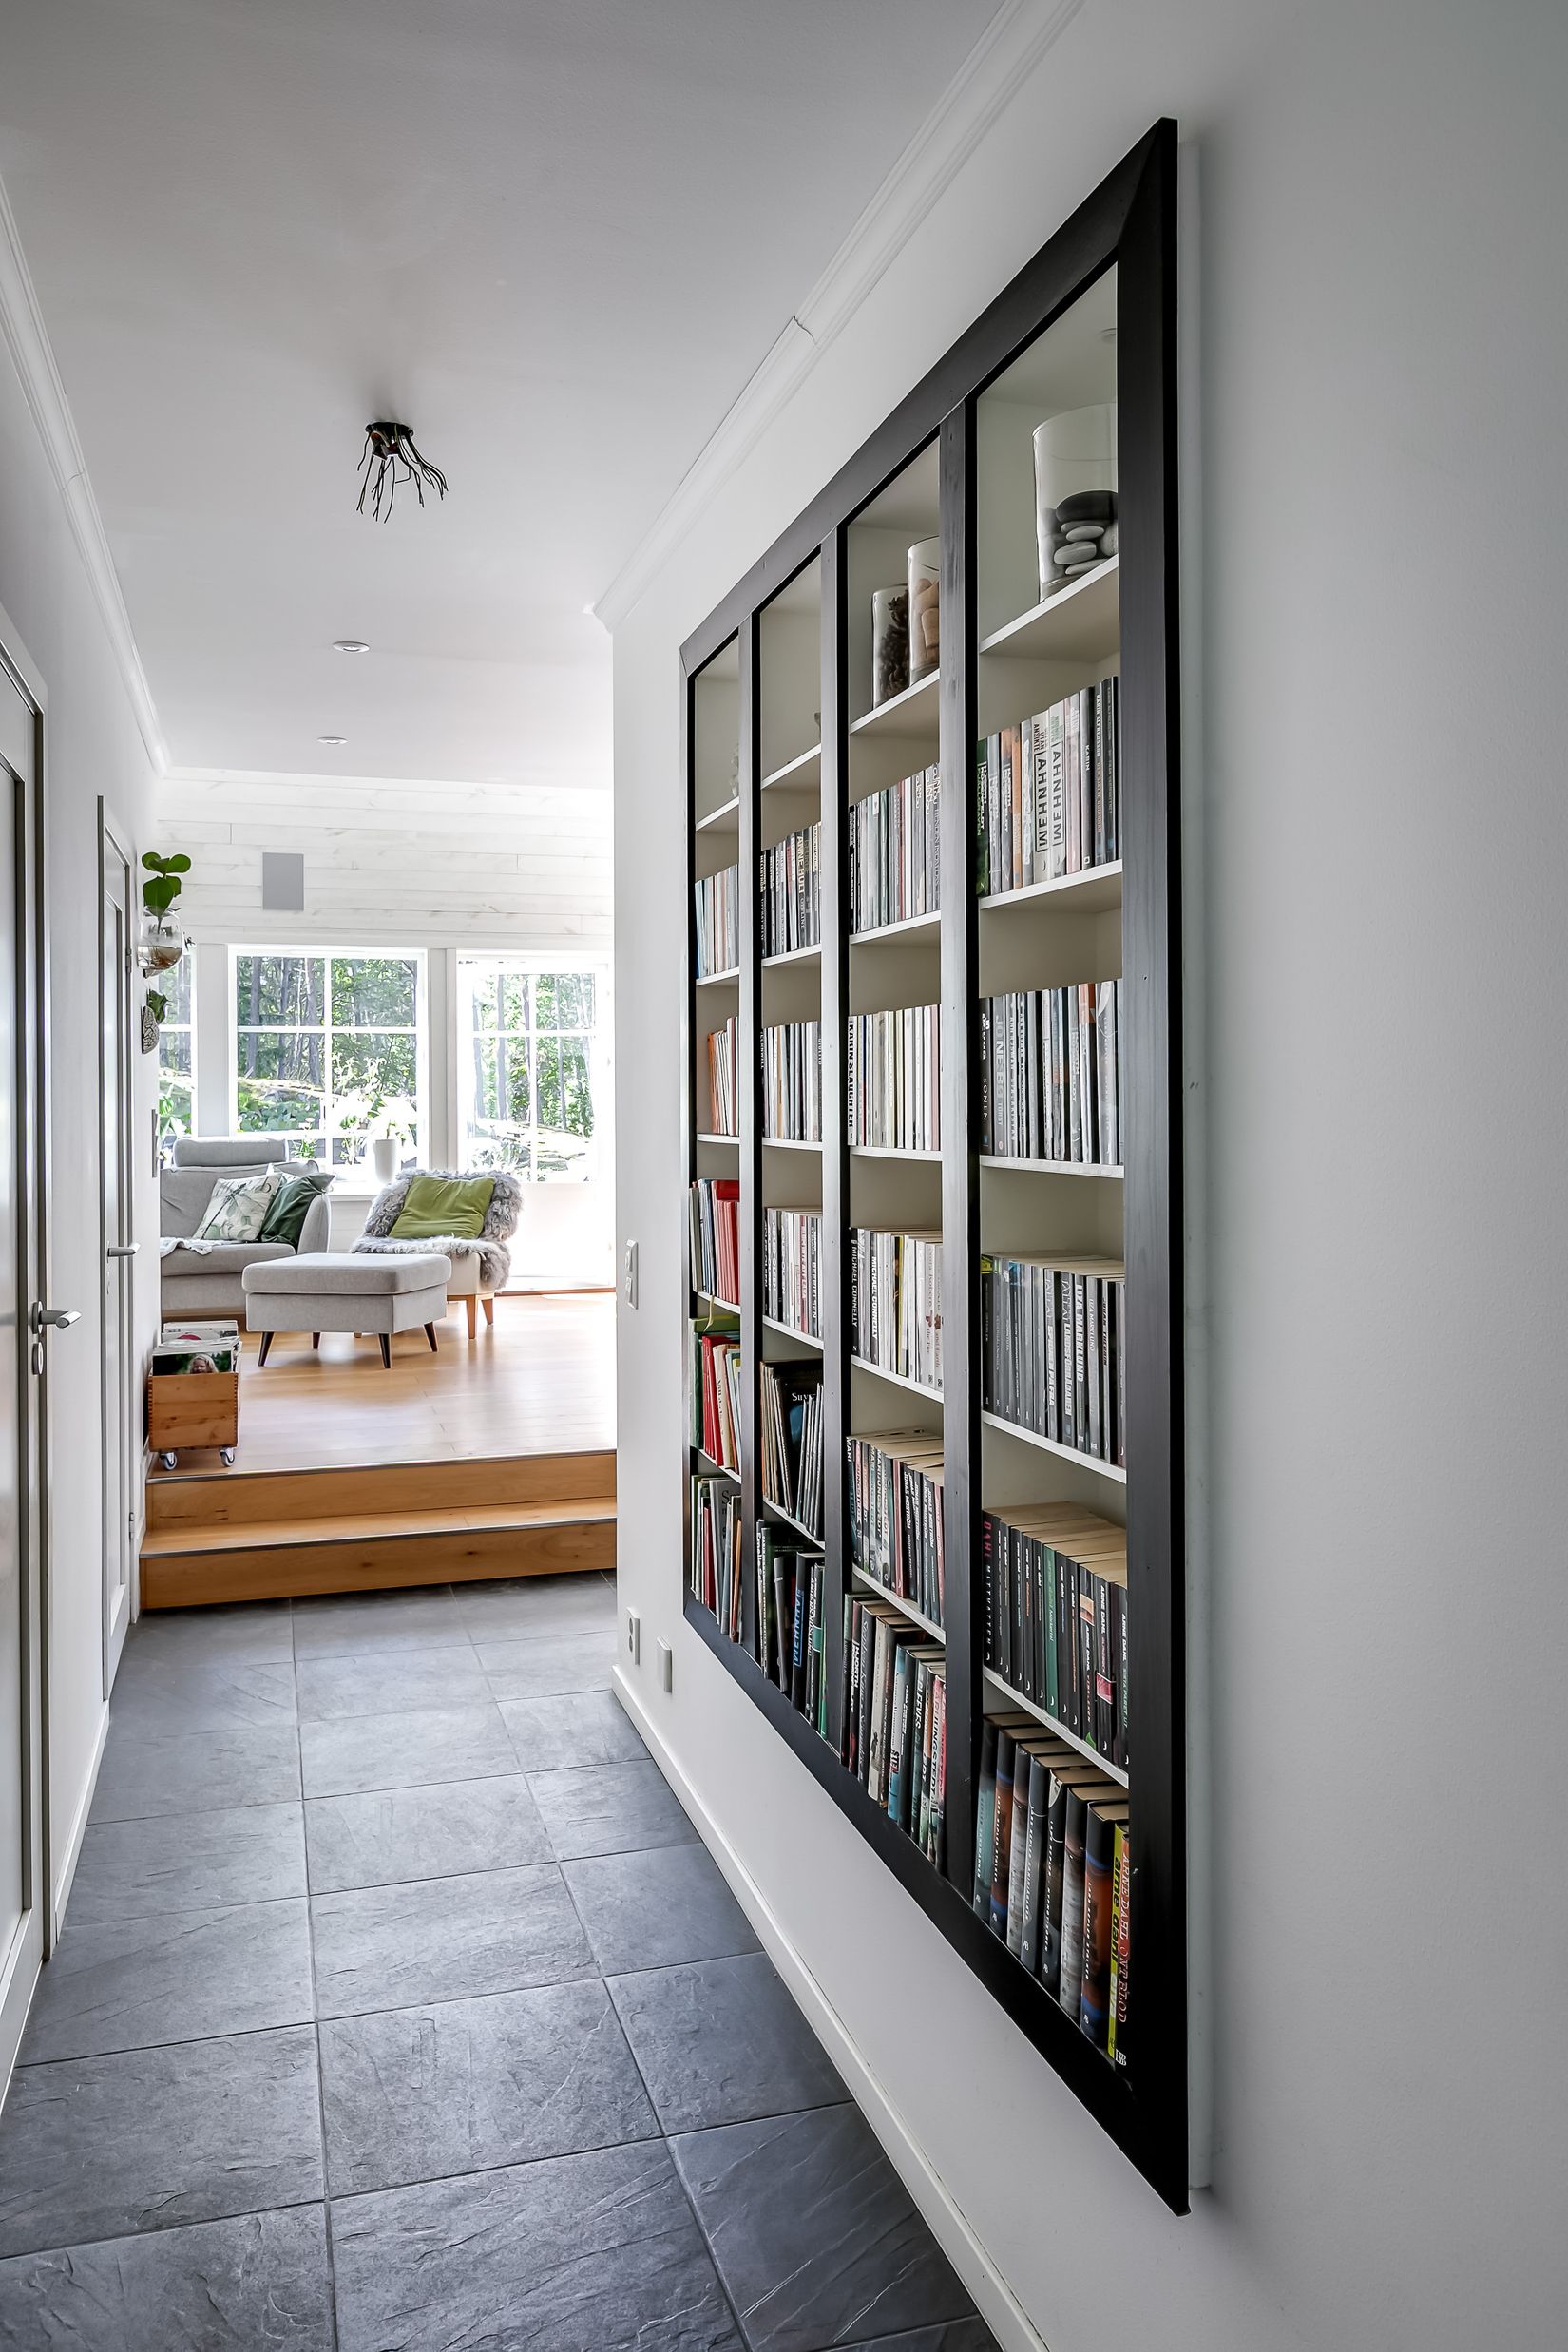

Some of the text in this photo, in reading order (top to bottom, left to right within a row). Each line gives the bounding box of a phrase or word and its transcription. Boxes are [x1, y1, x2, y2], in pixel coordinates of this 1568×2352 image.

[1038, 759, 1047, 846] AHNHEM
[1053, 751, 1061, 840] AHNHEM
[1119, 1854, 1130, 2023] ARNE DAHL ONT BLOD
